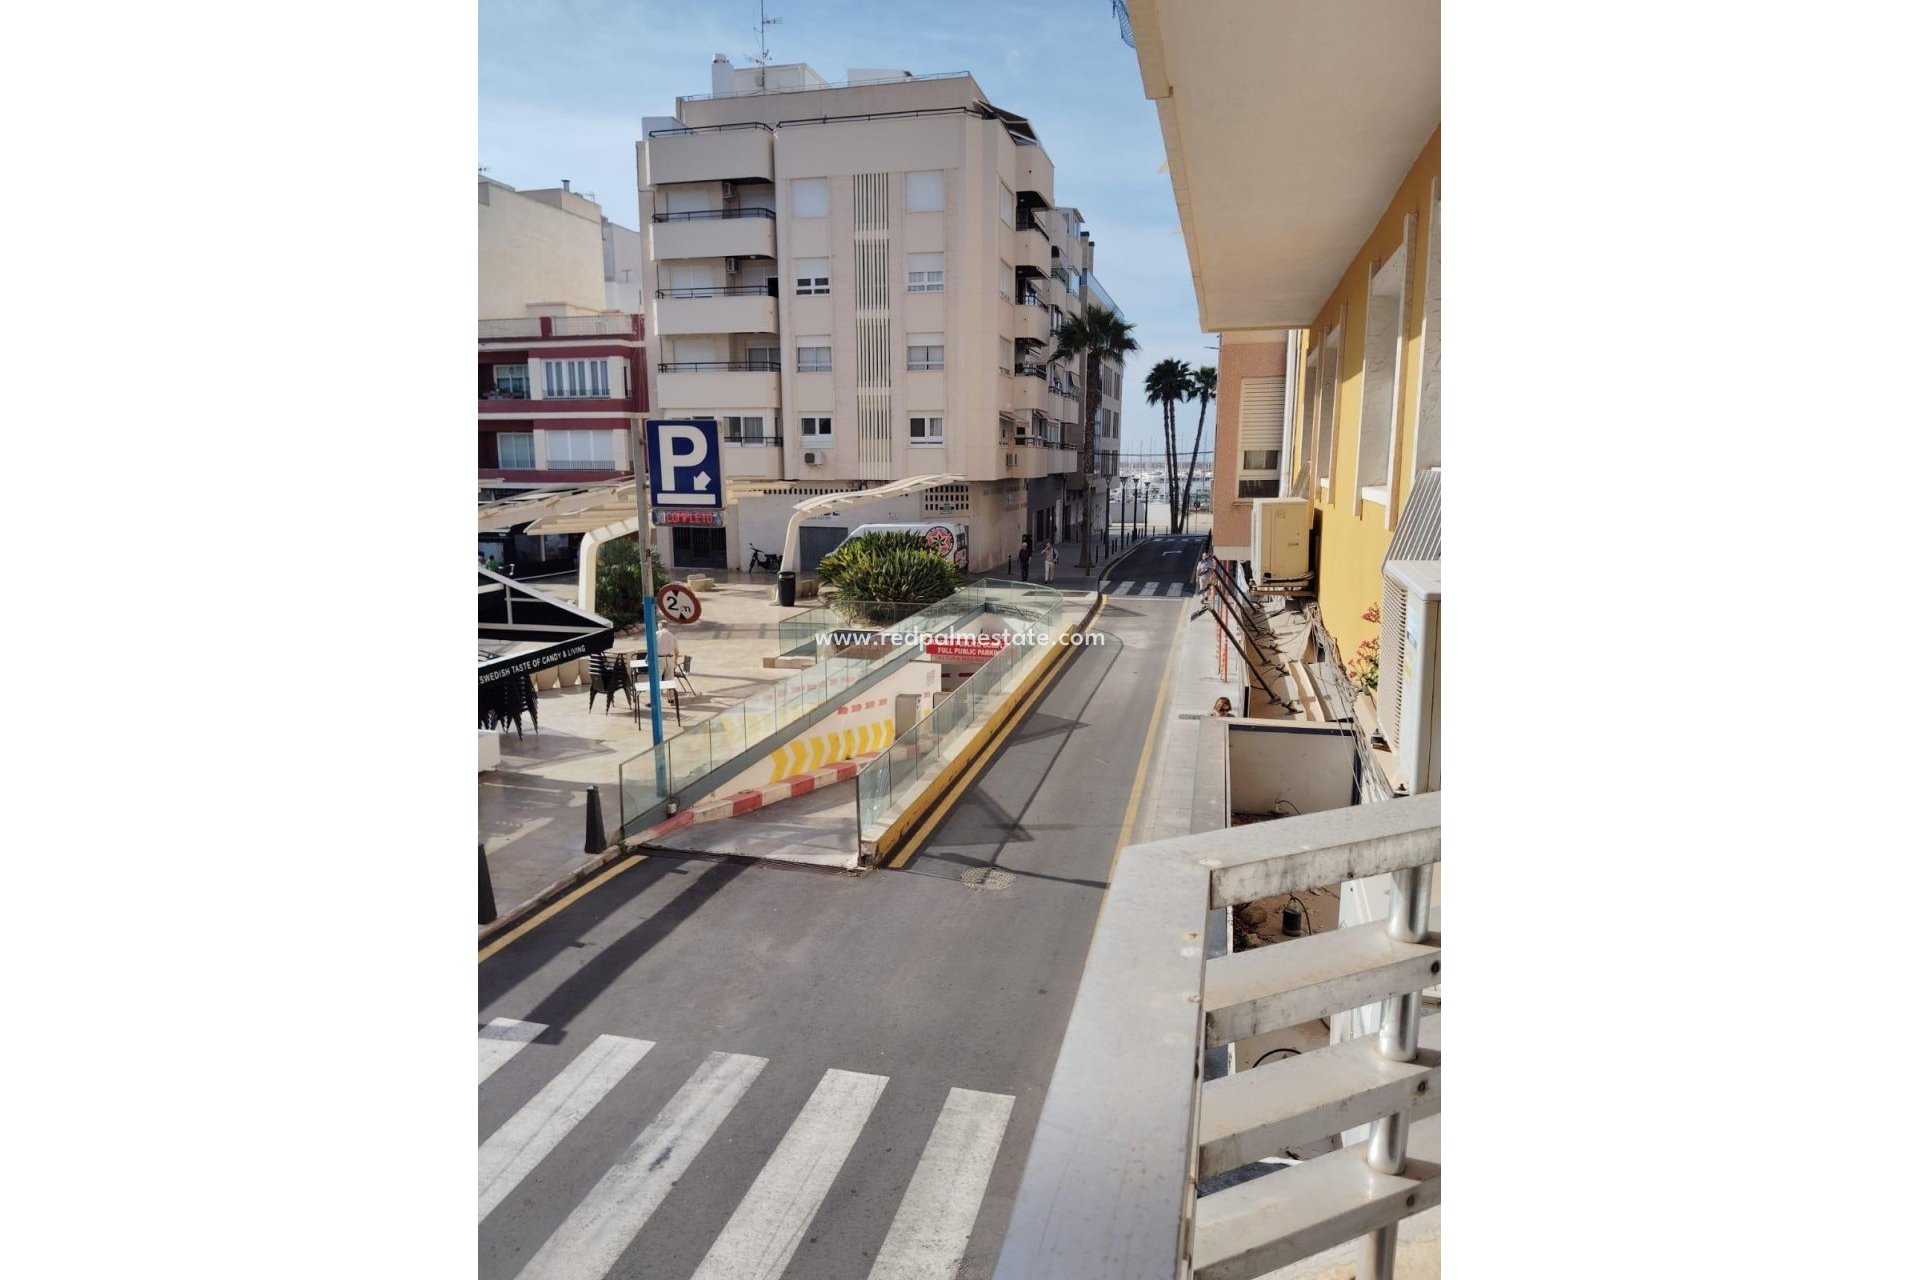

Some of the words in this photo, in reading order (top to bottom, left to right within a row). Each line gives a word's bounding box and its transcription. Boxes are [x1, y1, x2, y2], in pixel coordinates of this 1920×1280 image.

[657, 425, 708, 491] P
[479, 667, 511, 684] SWEDISH
[511, 661, 532, 674] TASTE
[532, 657, 541, 667] OF
[542, 652, 562, 665] CANDY
[567, 644, 586, 657] LIVING
[954, 647, 977, 655] PUBLIC
